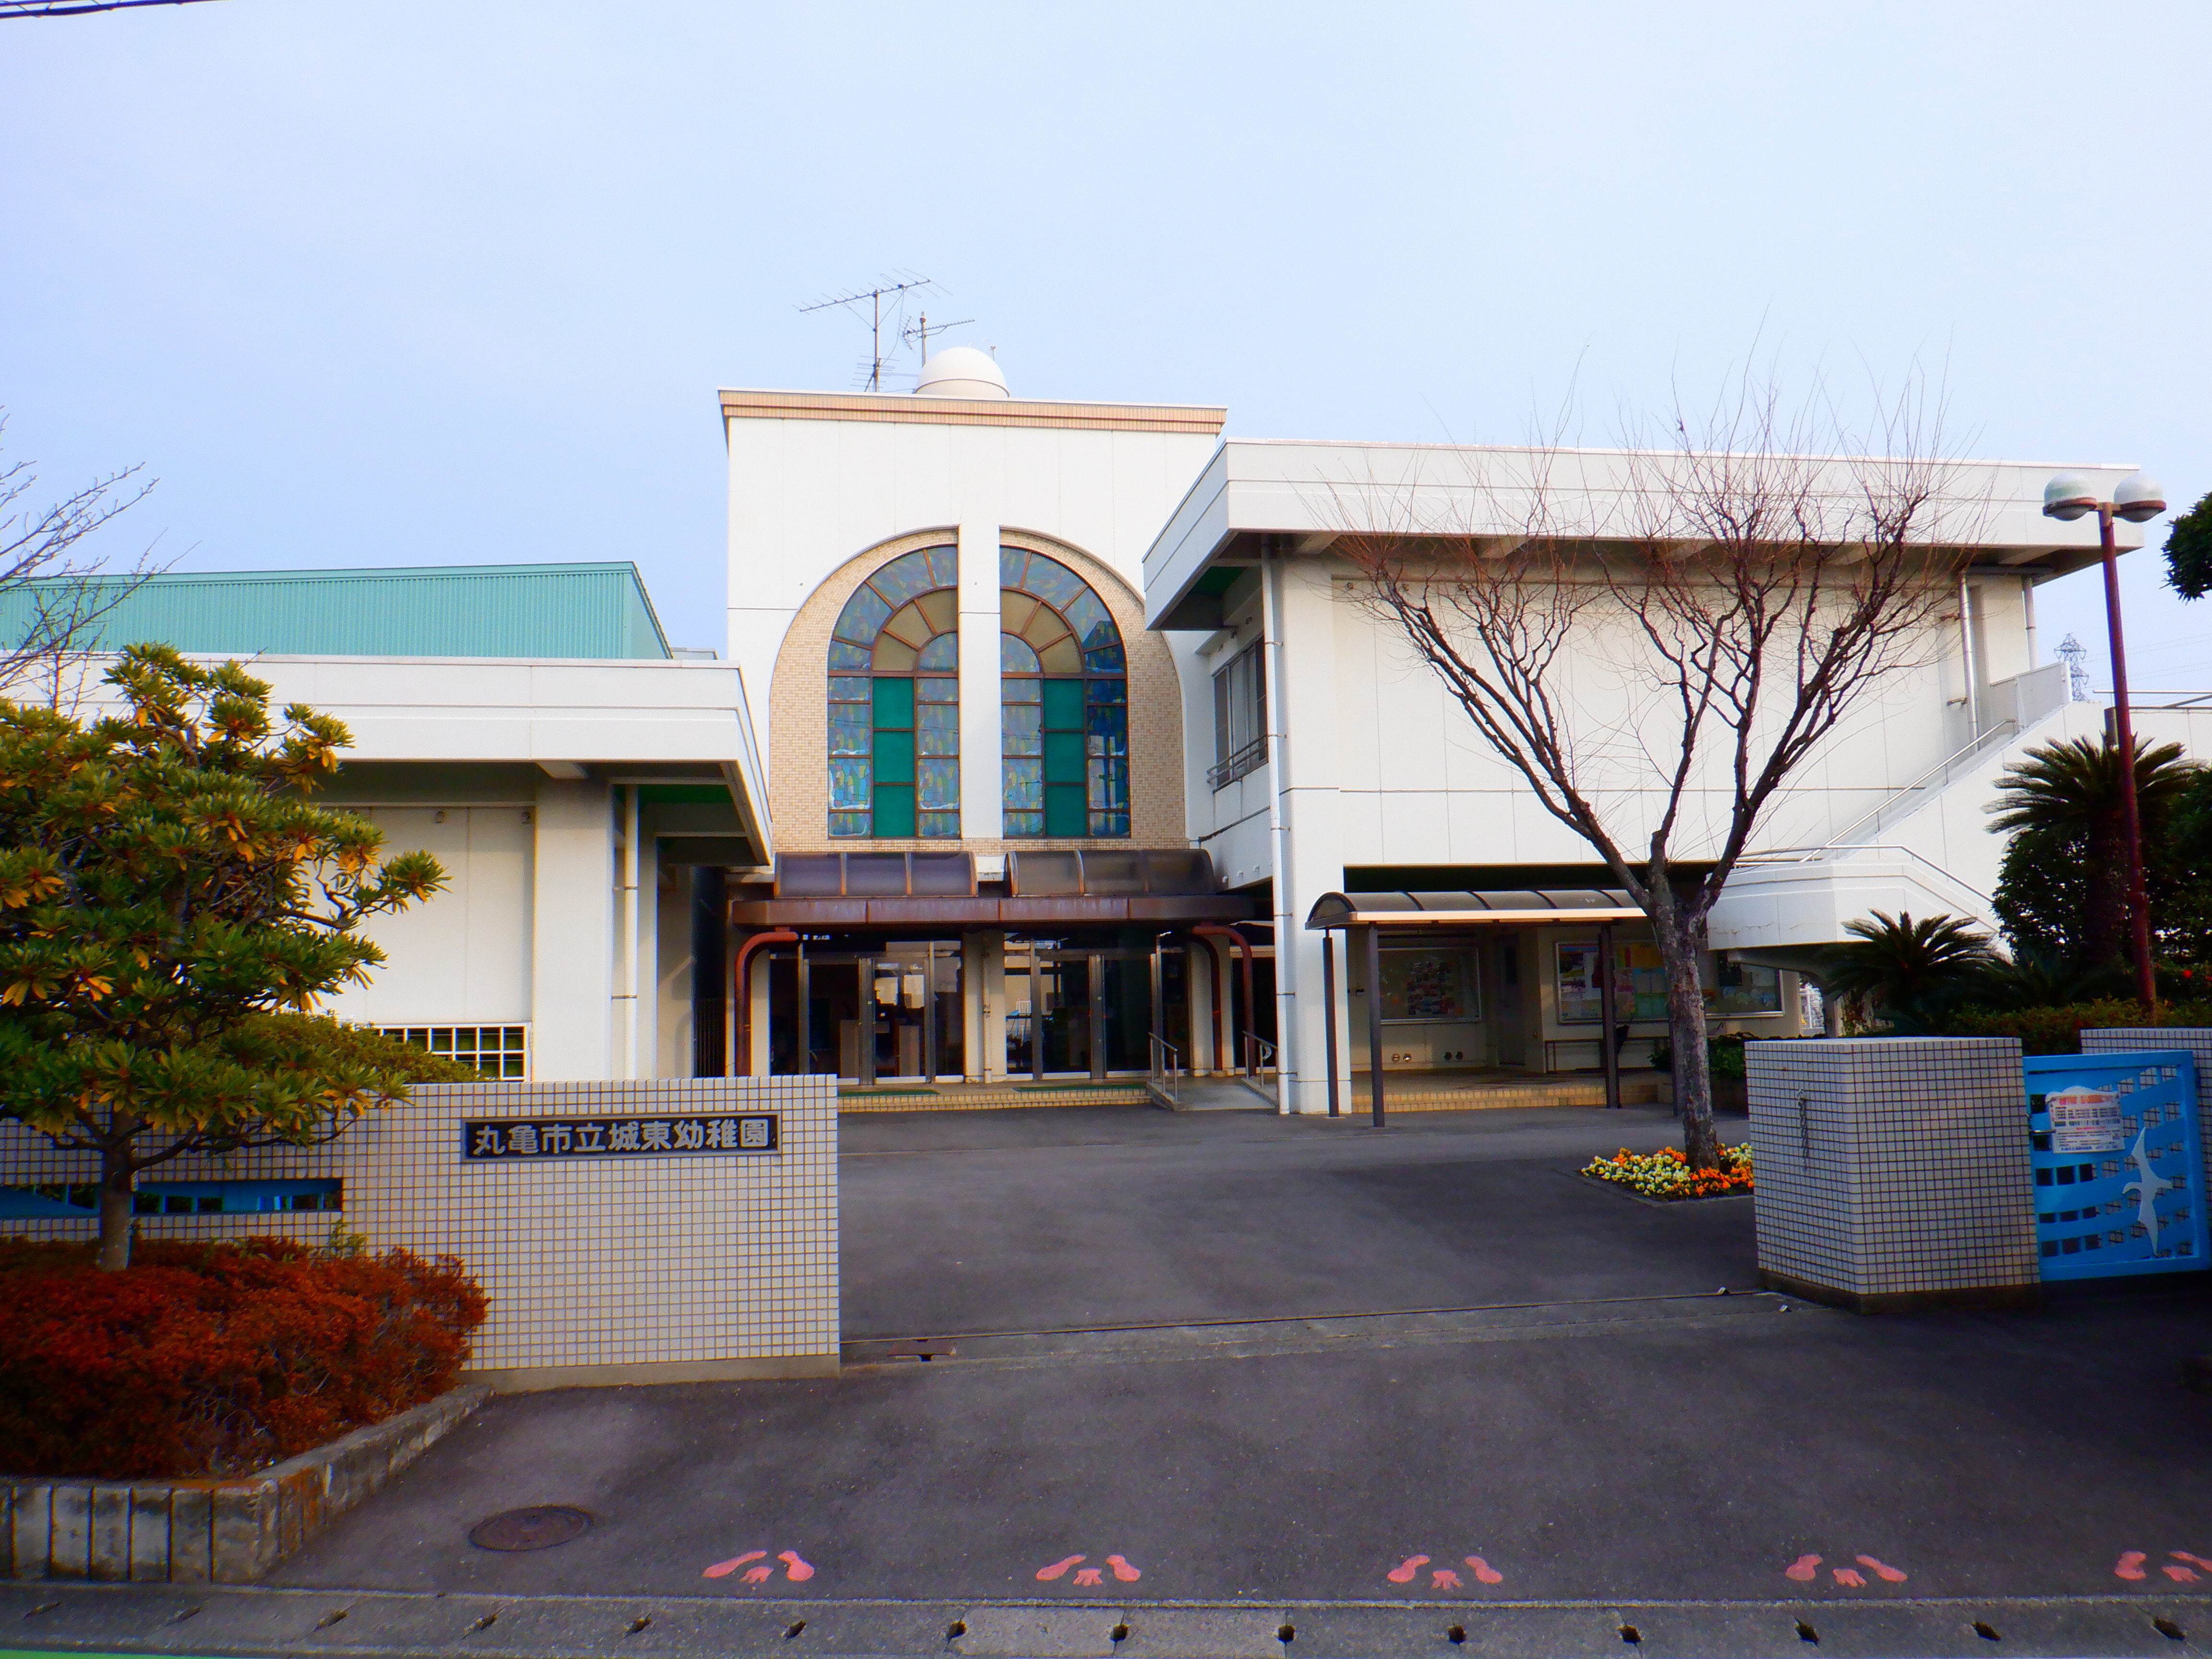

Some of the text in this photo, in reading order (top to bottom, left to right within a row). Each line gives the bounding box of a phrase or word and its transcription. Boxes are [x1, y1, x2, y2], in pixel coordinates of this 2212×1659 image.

[472, 1119, 769, 1155] 丸亀市立城東幼稚園
